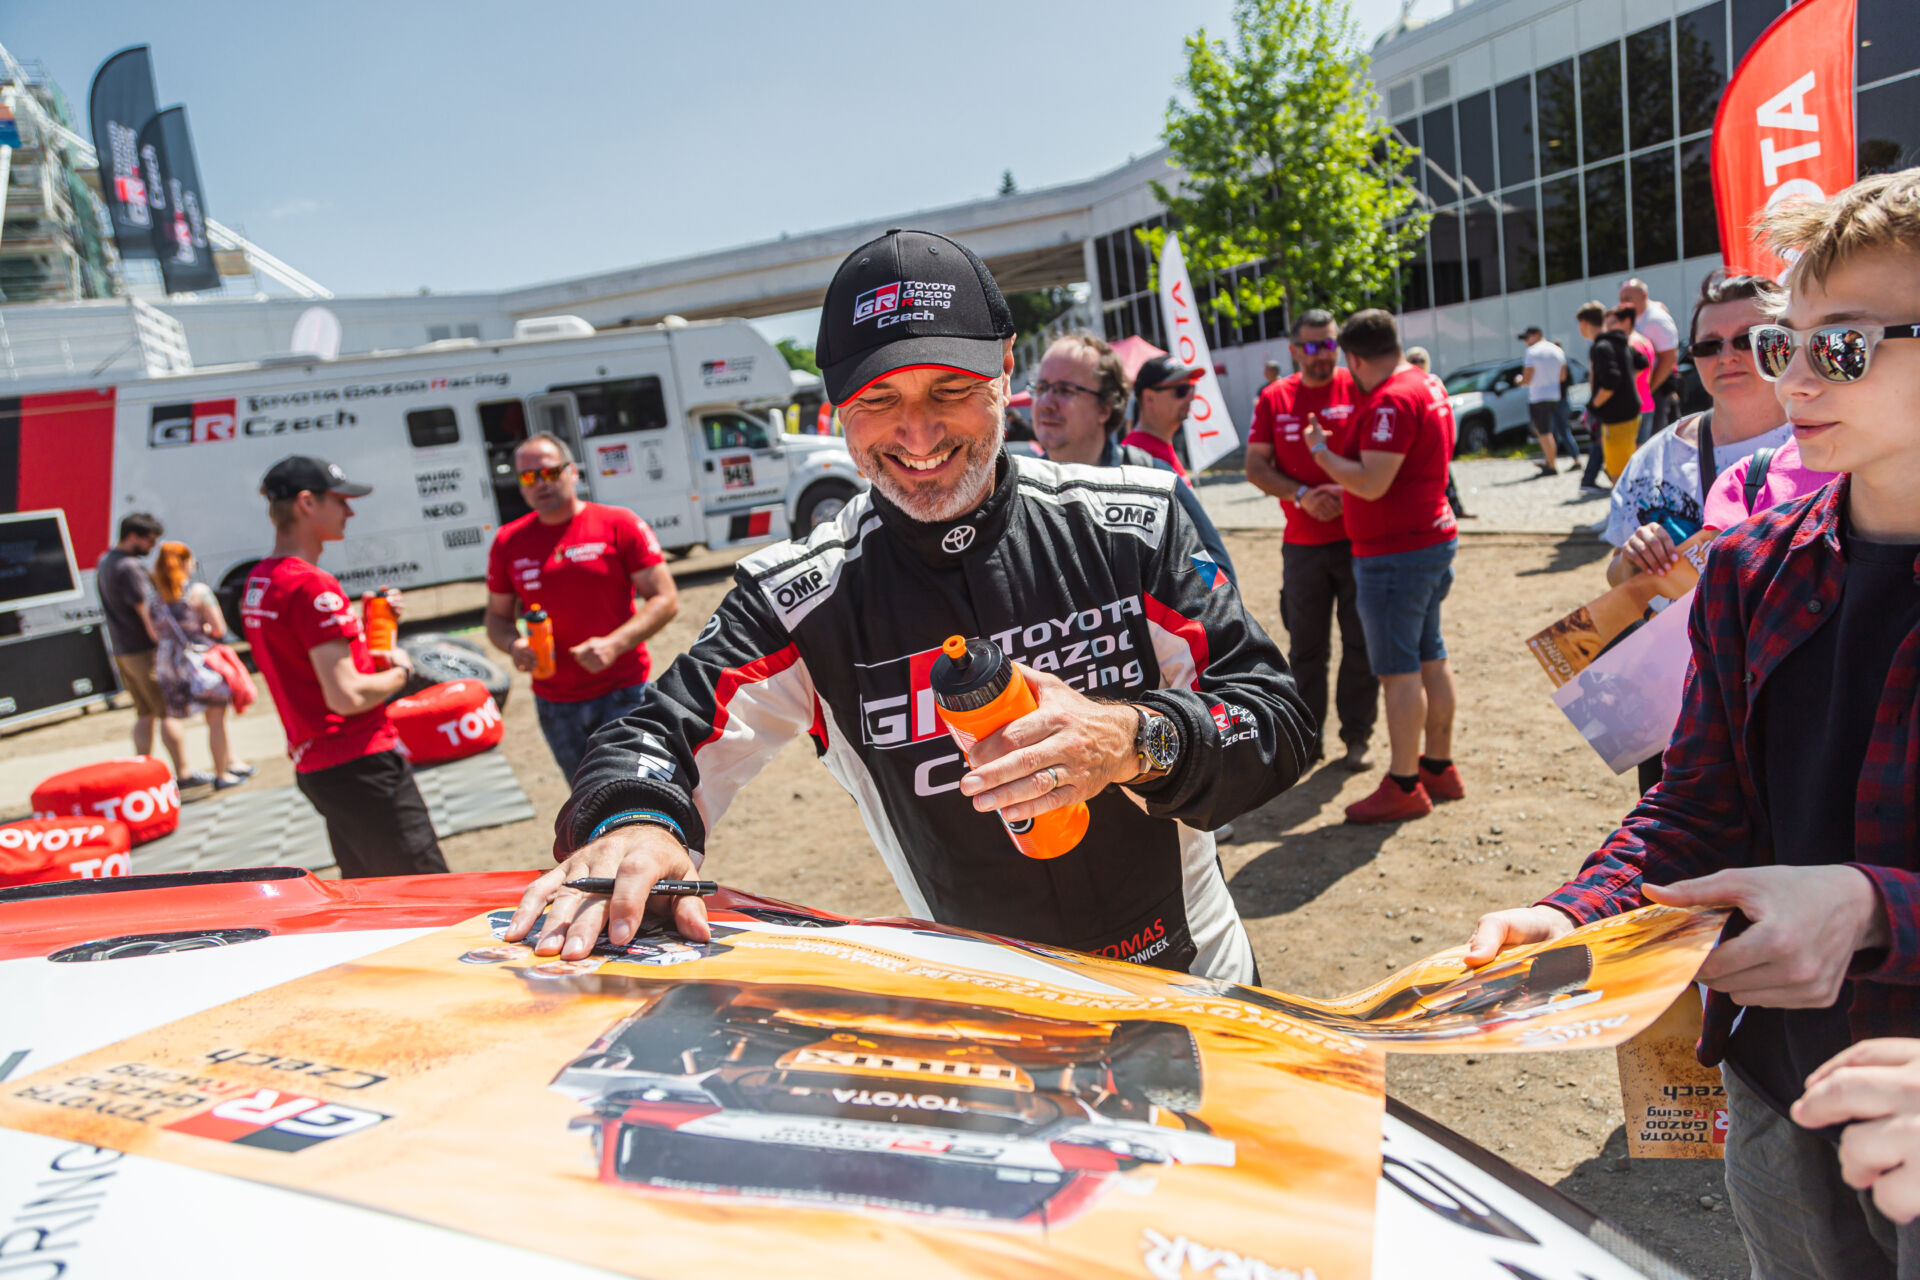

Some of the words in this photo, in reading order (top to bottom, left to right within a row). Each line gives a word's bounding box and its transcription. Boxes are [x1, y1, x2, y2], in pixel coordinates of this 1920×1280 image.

[902, 290, 952, 299] GAZOO
[903, 281, 956, 292] TOYOTA
[856, 292, 897, 319] GR
[901, 298, 951, 309] Racing
[877, 310, 935, 329] Czech
[1170, 280, 1221, 443] TOOTA
[153, 411, 236, 447] GR
[243, 410, 357, 438] Czech
[1104, 505, 1156, 528] OMP
[777, 570, 823, 607] OMP
[990, 594, 1143, 656] TOYOTA
[1012, 629, 1134, 672] AZOO
[1062, 658, 1144, 694] cing
[1221, 727, 1259, 748] zech
[70, 852, 131, 880] TO
[1123, 936, 1170, 964] DNICEK
[105, 1062, 250, 1096] Racing
[206, 1049, 388, 1091] Czech
[15, 1085, 162, 1123] TOYOTA
[65, 1075, 206, 1108] GAZOO
[832, 1088, 967, 1113] TOYOTA
[1662, 1085, 1727, 1101] zech
[210, 1088, 387, 1139] GR
[1645, 1120, 1708, 1131] GAZOO
[1647, 1106, 1708, 1119] Racing
[1640, 1132, 1708, 1143] TOYOTA
